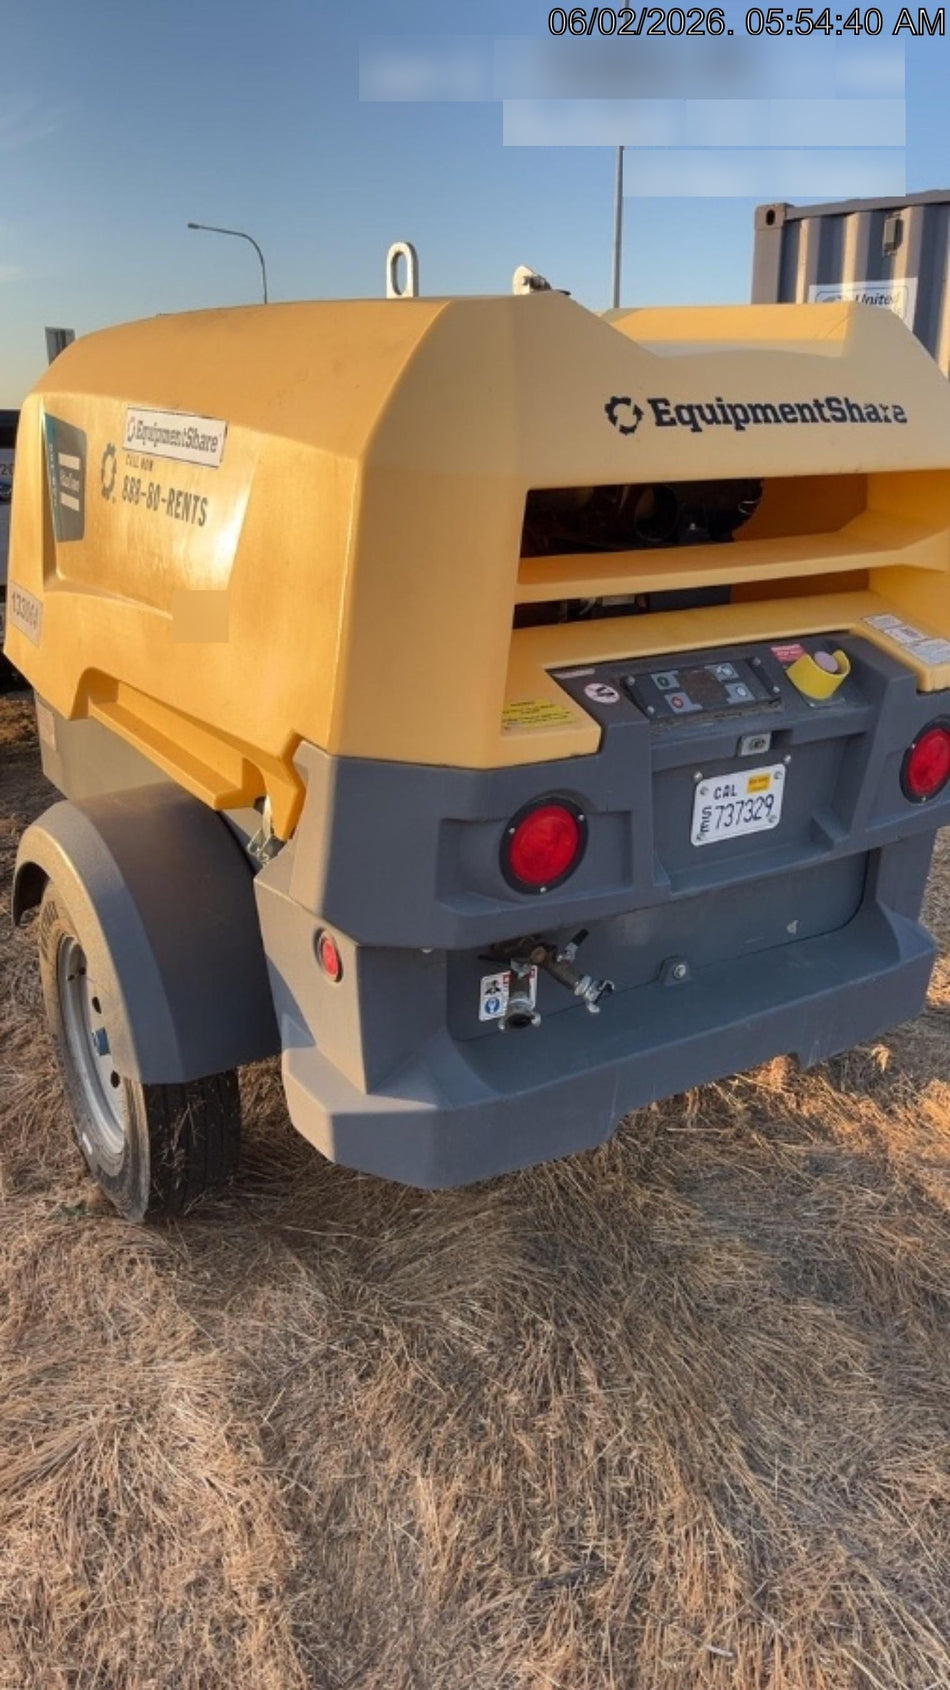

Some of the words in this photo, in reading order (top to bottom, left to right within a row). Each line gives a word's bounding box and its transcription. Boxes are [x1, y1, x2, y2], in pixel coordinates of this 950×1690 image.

[647, 396, 908, 433] EquipmentShare
[136, 419, 219, 454] EquipmentShare
[121, 474, 208, 528] 888-80-RENTS
[713, 784, 738, 801] CAL
[714, 793, 775, 831] 737329
